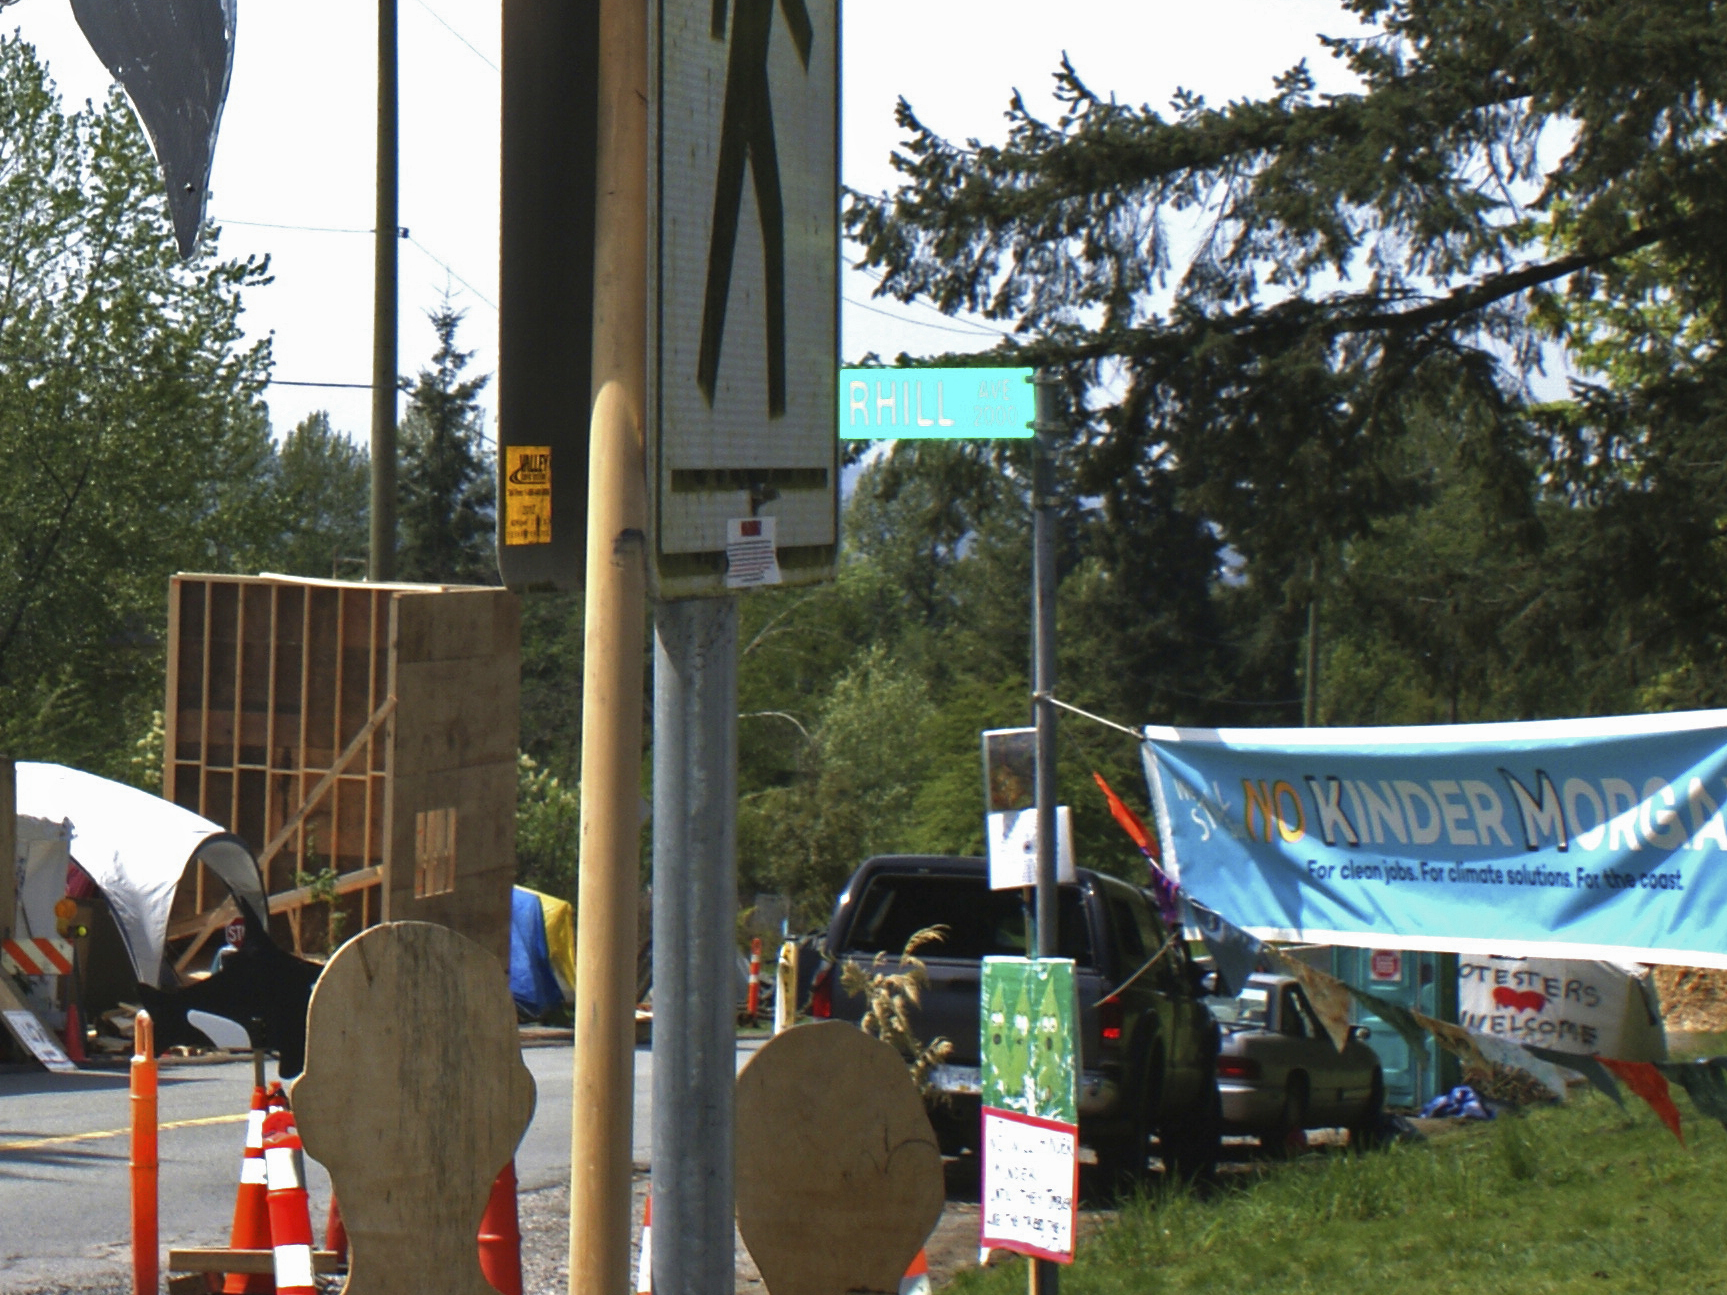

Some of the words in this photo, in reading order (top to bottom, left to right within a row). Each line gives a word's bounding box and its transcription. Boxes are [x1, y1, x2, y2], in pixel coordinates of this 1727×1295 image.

[978, 379, 1011, 401] AVE
[1242, 779, 1306, 843] NO
[1305, 775, 1513, 847] KINDER
[1499, 767, 1727, 852] MORGA
[1307, 860, 1335, 879] For
[1340, 859, 1382, 880] clean
[1383, 859, 1418, 885] jobs.
[1420, 861, 1444, 882] For
[1448, 860, 1503, 884] climate
[1507, 863, 1574, 888] solutions.
[1577, 866, 1599, 889] For
[1602, 868, 1636, 888] the
[1639, 869, 1684, 890] coast.
[1460, 1010, 1598, 1044] WELCOME
